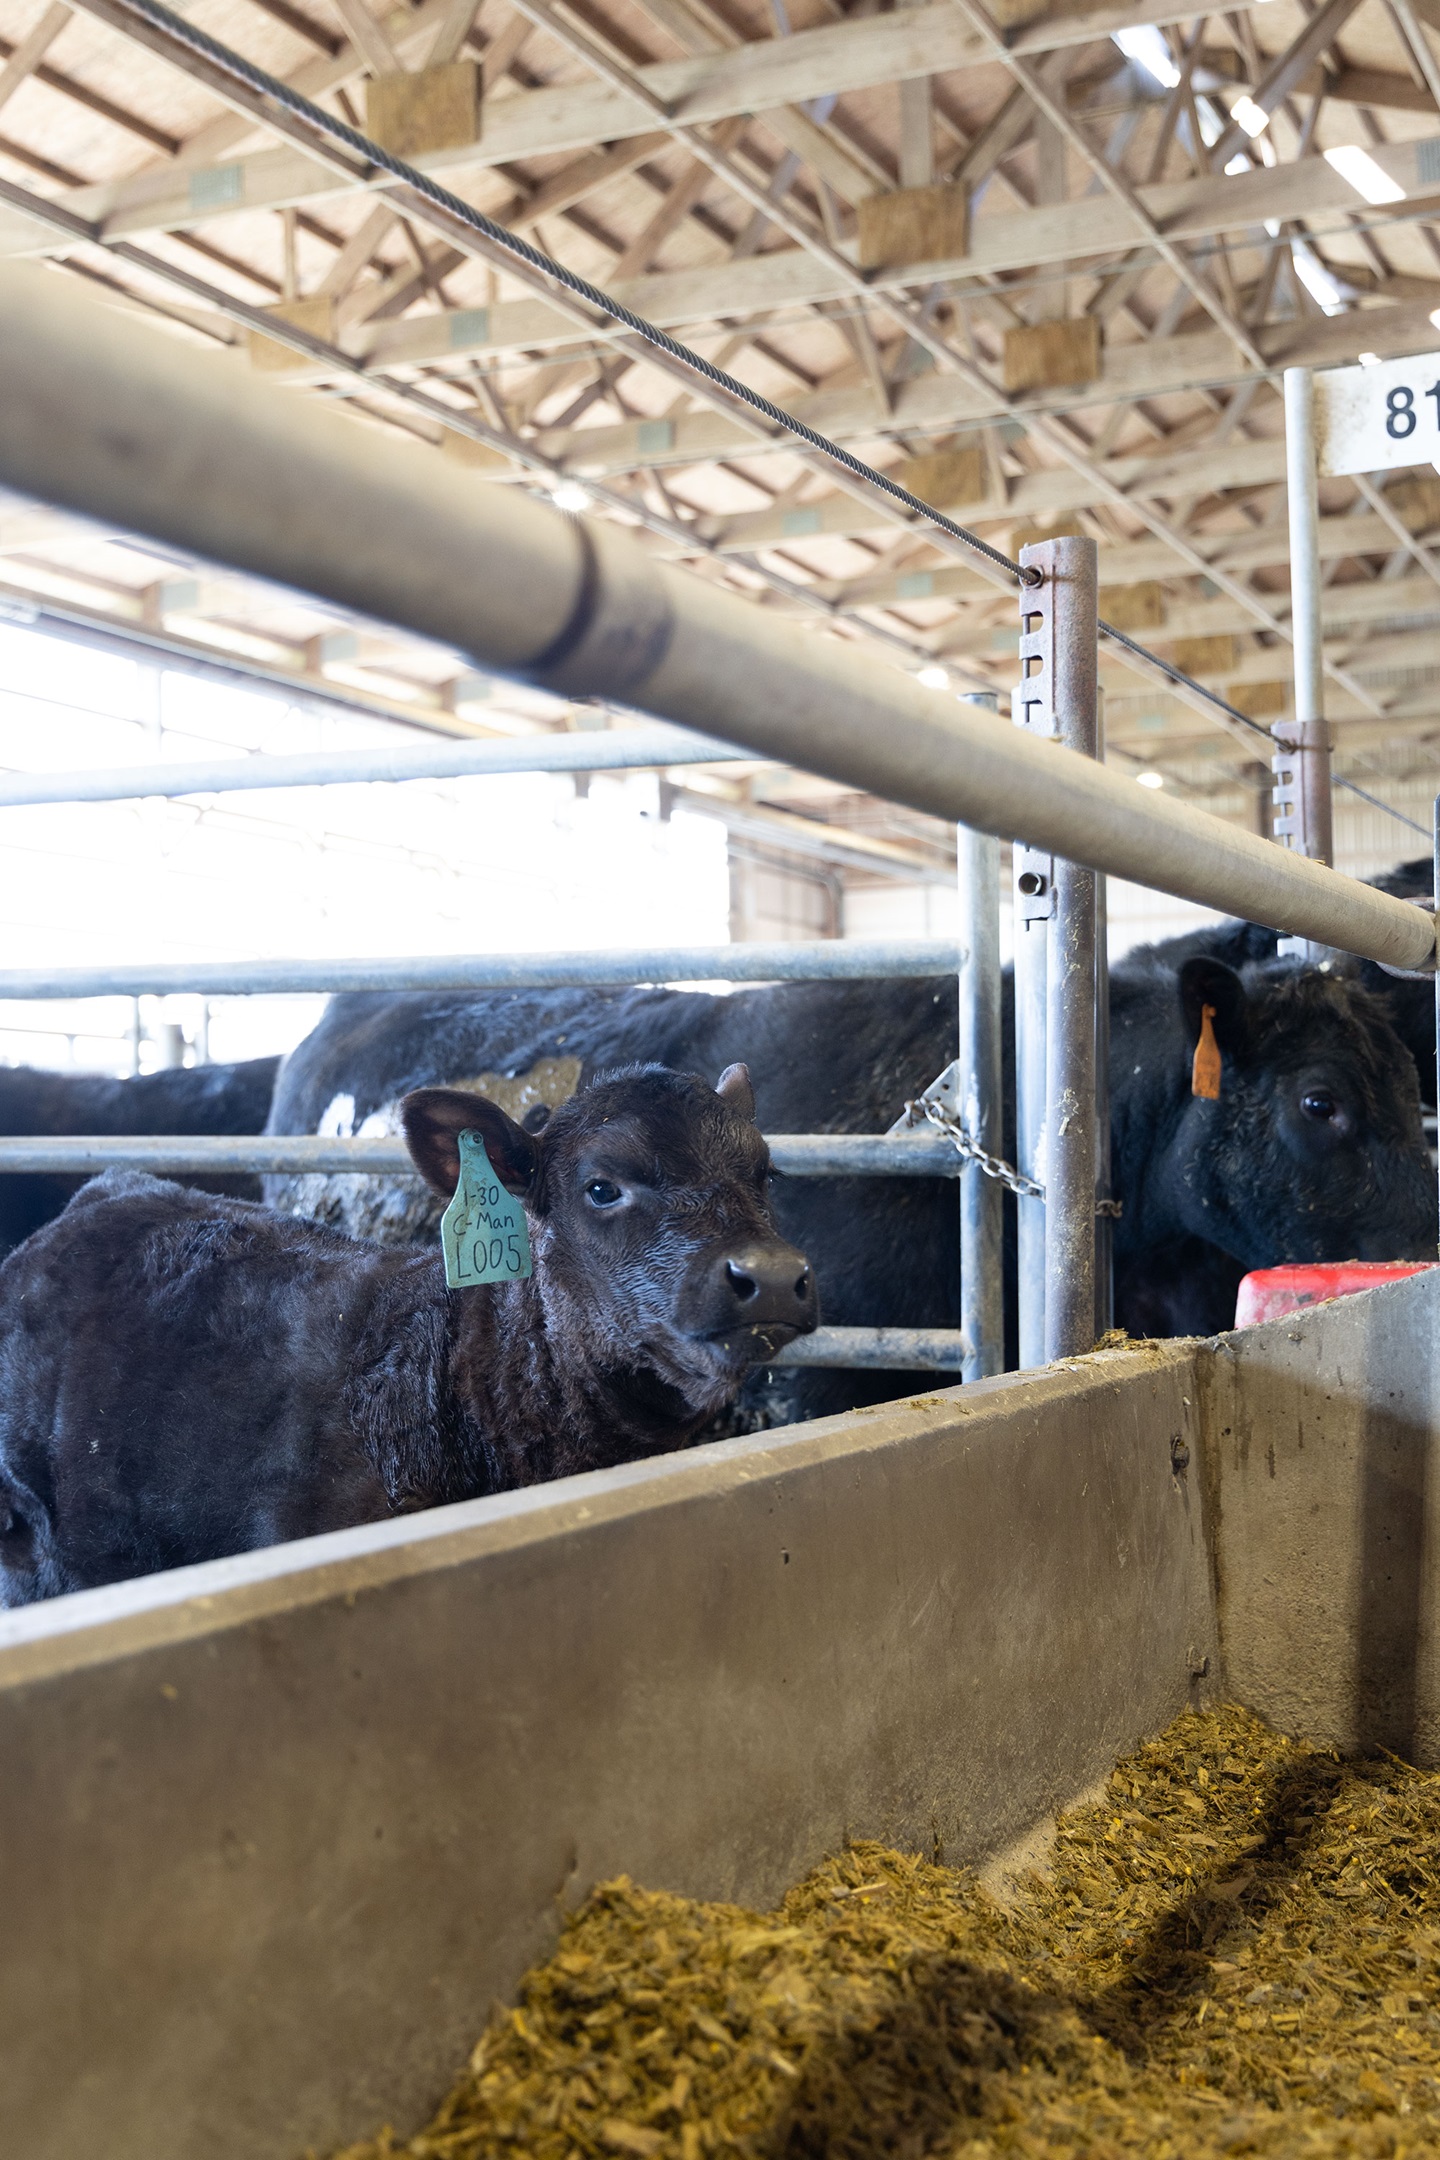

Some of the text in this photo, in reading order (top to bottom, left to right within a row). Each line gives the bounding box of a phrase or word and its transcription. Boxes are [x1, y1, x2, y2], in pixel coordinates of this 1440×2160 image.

[1386, 379, 1440, 439] 81
[464, 1184, 499, 1207] 1-30
[453, 1212, 515, 1236] C-Man
[456, 1234, 521, 1279] L005
